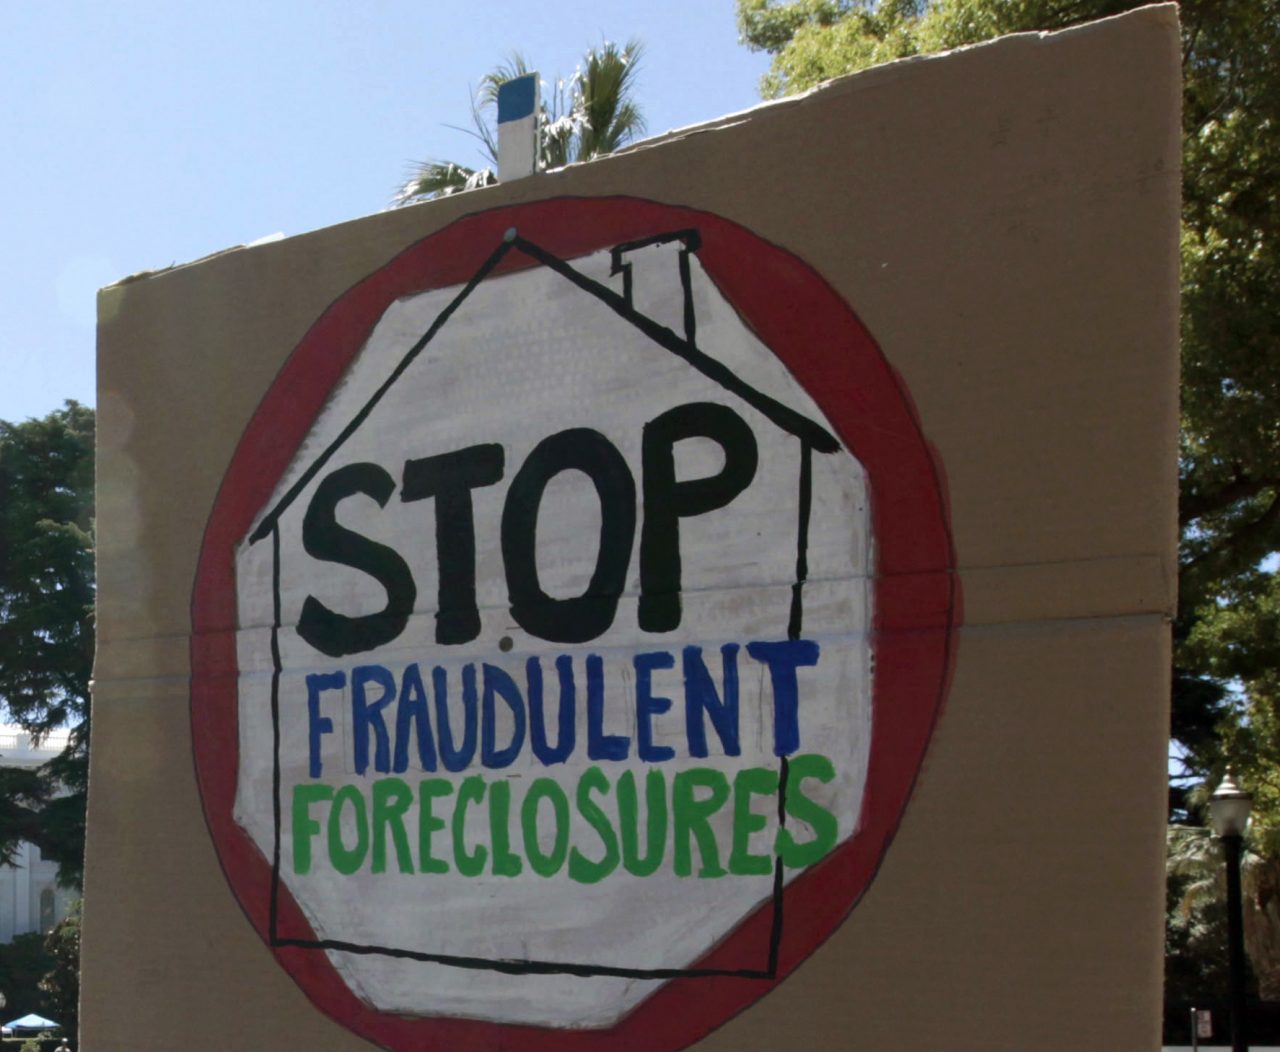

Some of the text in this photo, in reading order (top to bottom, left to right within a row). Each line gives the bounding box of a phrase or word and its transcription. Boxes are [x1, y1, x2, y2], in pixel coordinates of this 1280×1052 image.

[296, 401, 758, 657] STOP
[306, 639, 819, 779] FRAUDULENT
[292, 754, 839, 883] FORECLOSURES
